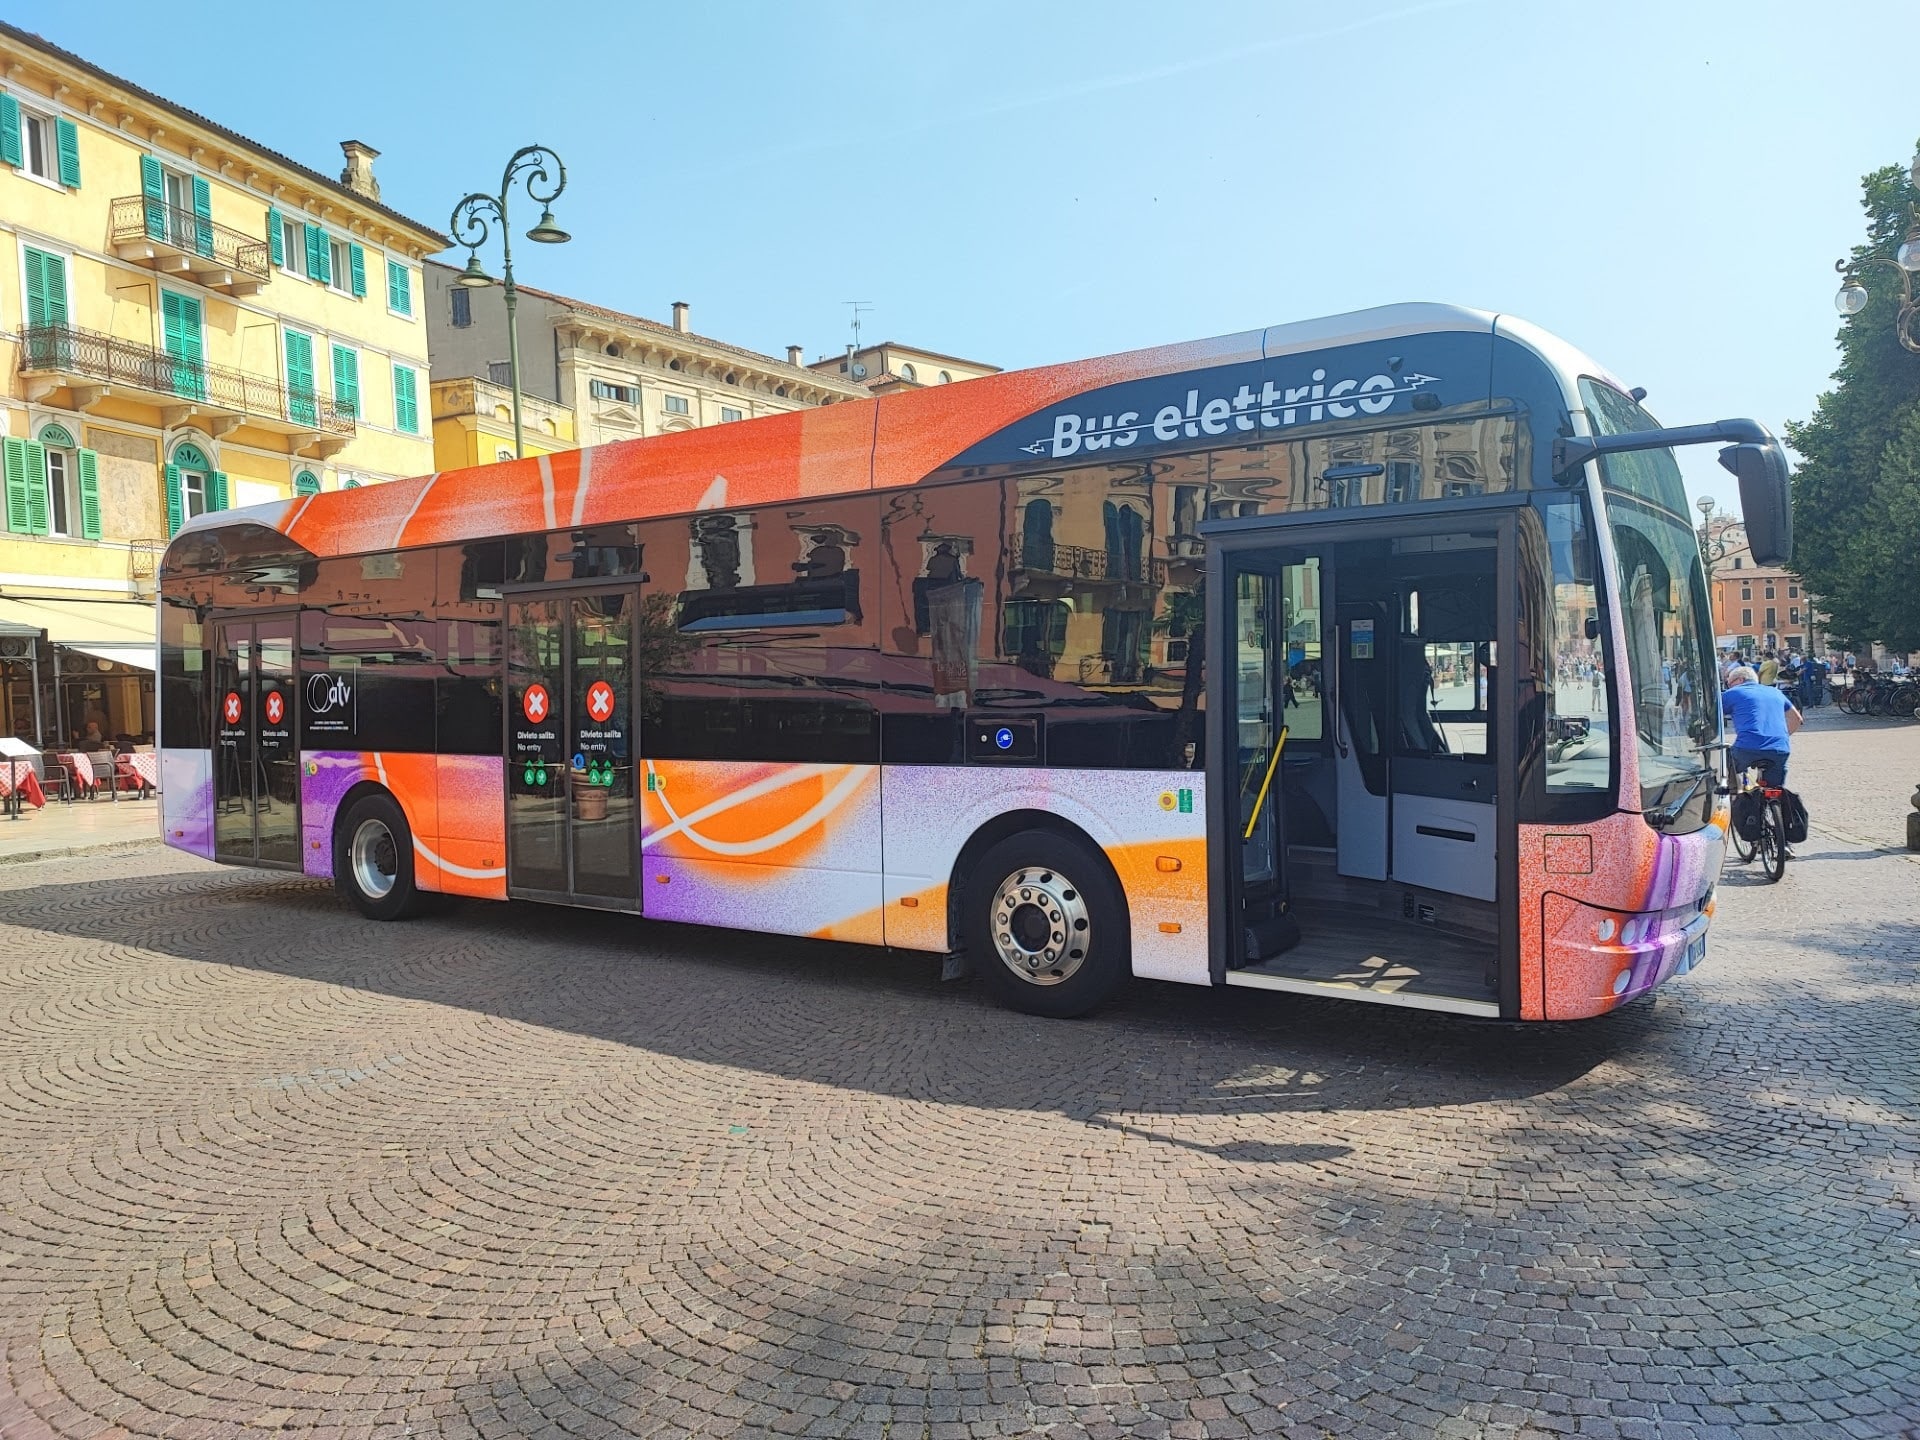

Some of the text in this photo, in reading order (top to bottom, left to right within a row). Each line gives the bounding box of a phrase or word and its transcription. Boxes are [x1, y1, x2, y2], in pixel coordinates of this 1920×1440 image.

[1052, 368, 1396, 458] Bus elettrico
[517, 731, 555, 740] Divieto salita
[580, 730, 622, 739] Divieto salita
[517, 743, 542, 753] No entry
[580, 742, 607, 753] No entry
